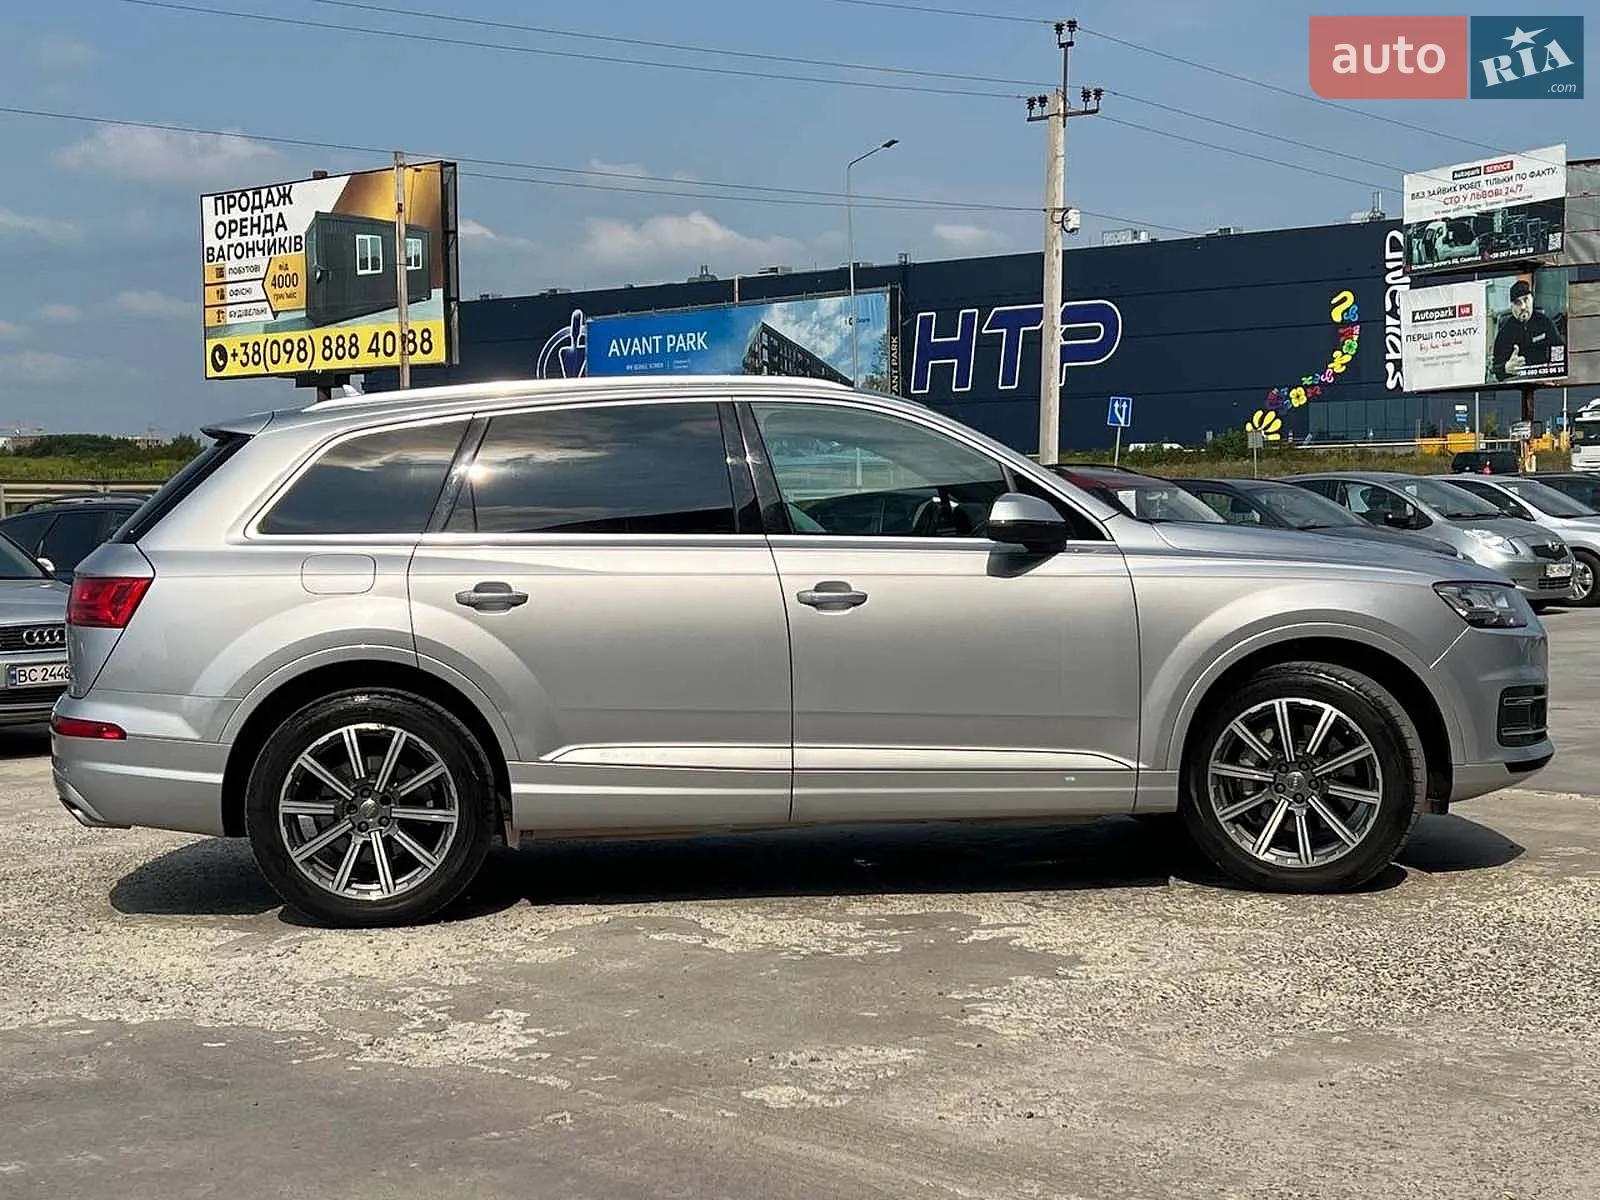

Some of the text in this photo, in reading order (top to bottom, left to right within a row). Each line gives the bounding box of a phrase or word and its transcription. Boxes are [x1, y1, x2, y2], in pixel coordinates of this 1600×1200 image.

[1515, 173, 1527, 181] ПО
[214, 185, 293, 216] ПРОДАЖ
[1443, 195, 1460, 205] СТО
[1462, 194, 1467, 202] У
[215, 212, 288, 240] ОРЕНДА
[206, 235, 303, 263] ВАГОНЧИКІВ
[271, 272, 299, 289] 4000
[1415, 306, 1454, 320] Autopark
[608, 331, 708, 358] AVANT PARK
[1405, 332, 1433, 342] ПЕРШІ
[1435, 330, 1447, 339] ПО
[231, 335, 316, 372] +38(098)
[321, 333, 359, 361] 888
[891, 369, 899, 395] ANT
[18, 668, 38, 683] BC
